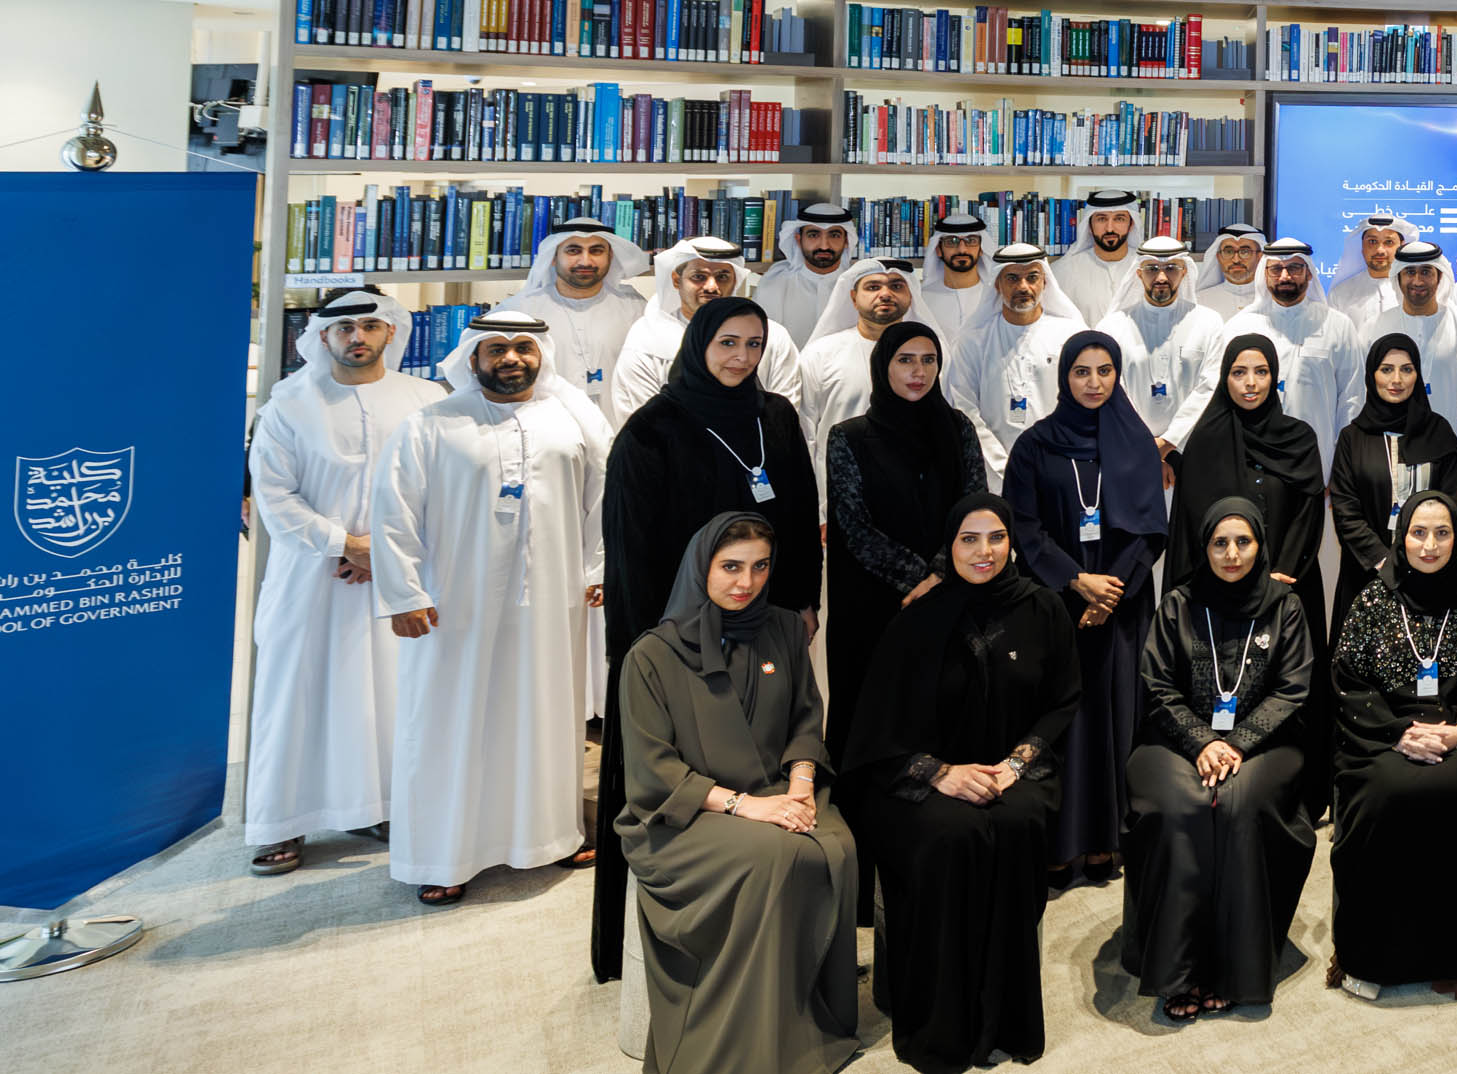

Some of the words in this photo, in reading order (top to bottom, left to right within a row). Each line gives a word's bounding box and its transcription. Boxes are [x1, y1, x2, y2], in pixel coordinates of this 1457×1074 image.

[1342, 180, 1392, 193] الحكومية
[1394, 180, 1433, 193] القيادة
[1342, 203, 1393, 218] خطى
[1396, 203, 1435, 218] على
[294, 275, 357, 285] Handbooks
[127, 553, 182, 570] كلية
[23, 573, 46, 586] بن
[50, 564, 123, 580] محمد
[79, 594, 110, 608] BIN
[115, 585, 183, 603] RASHID
[0, 621, 28, 634] OL
[30, 616, 56, 629] OF
[59, 598, 183, 625] GOVERNMENT
